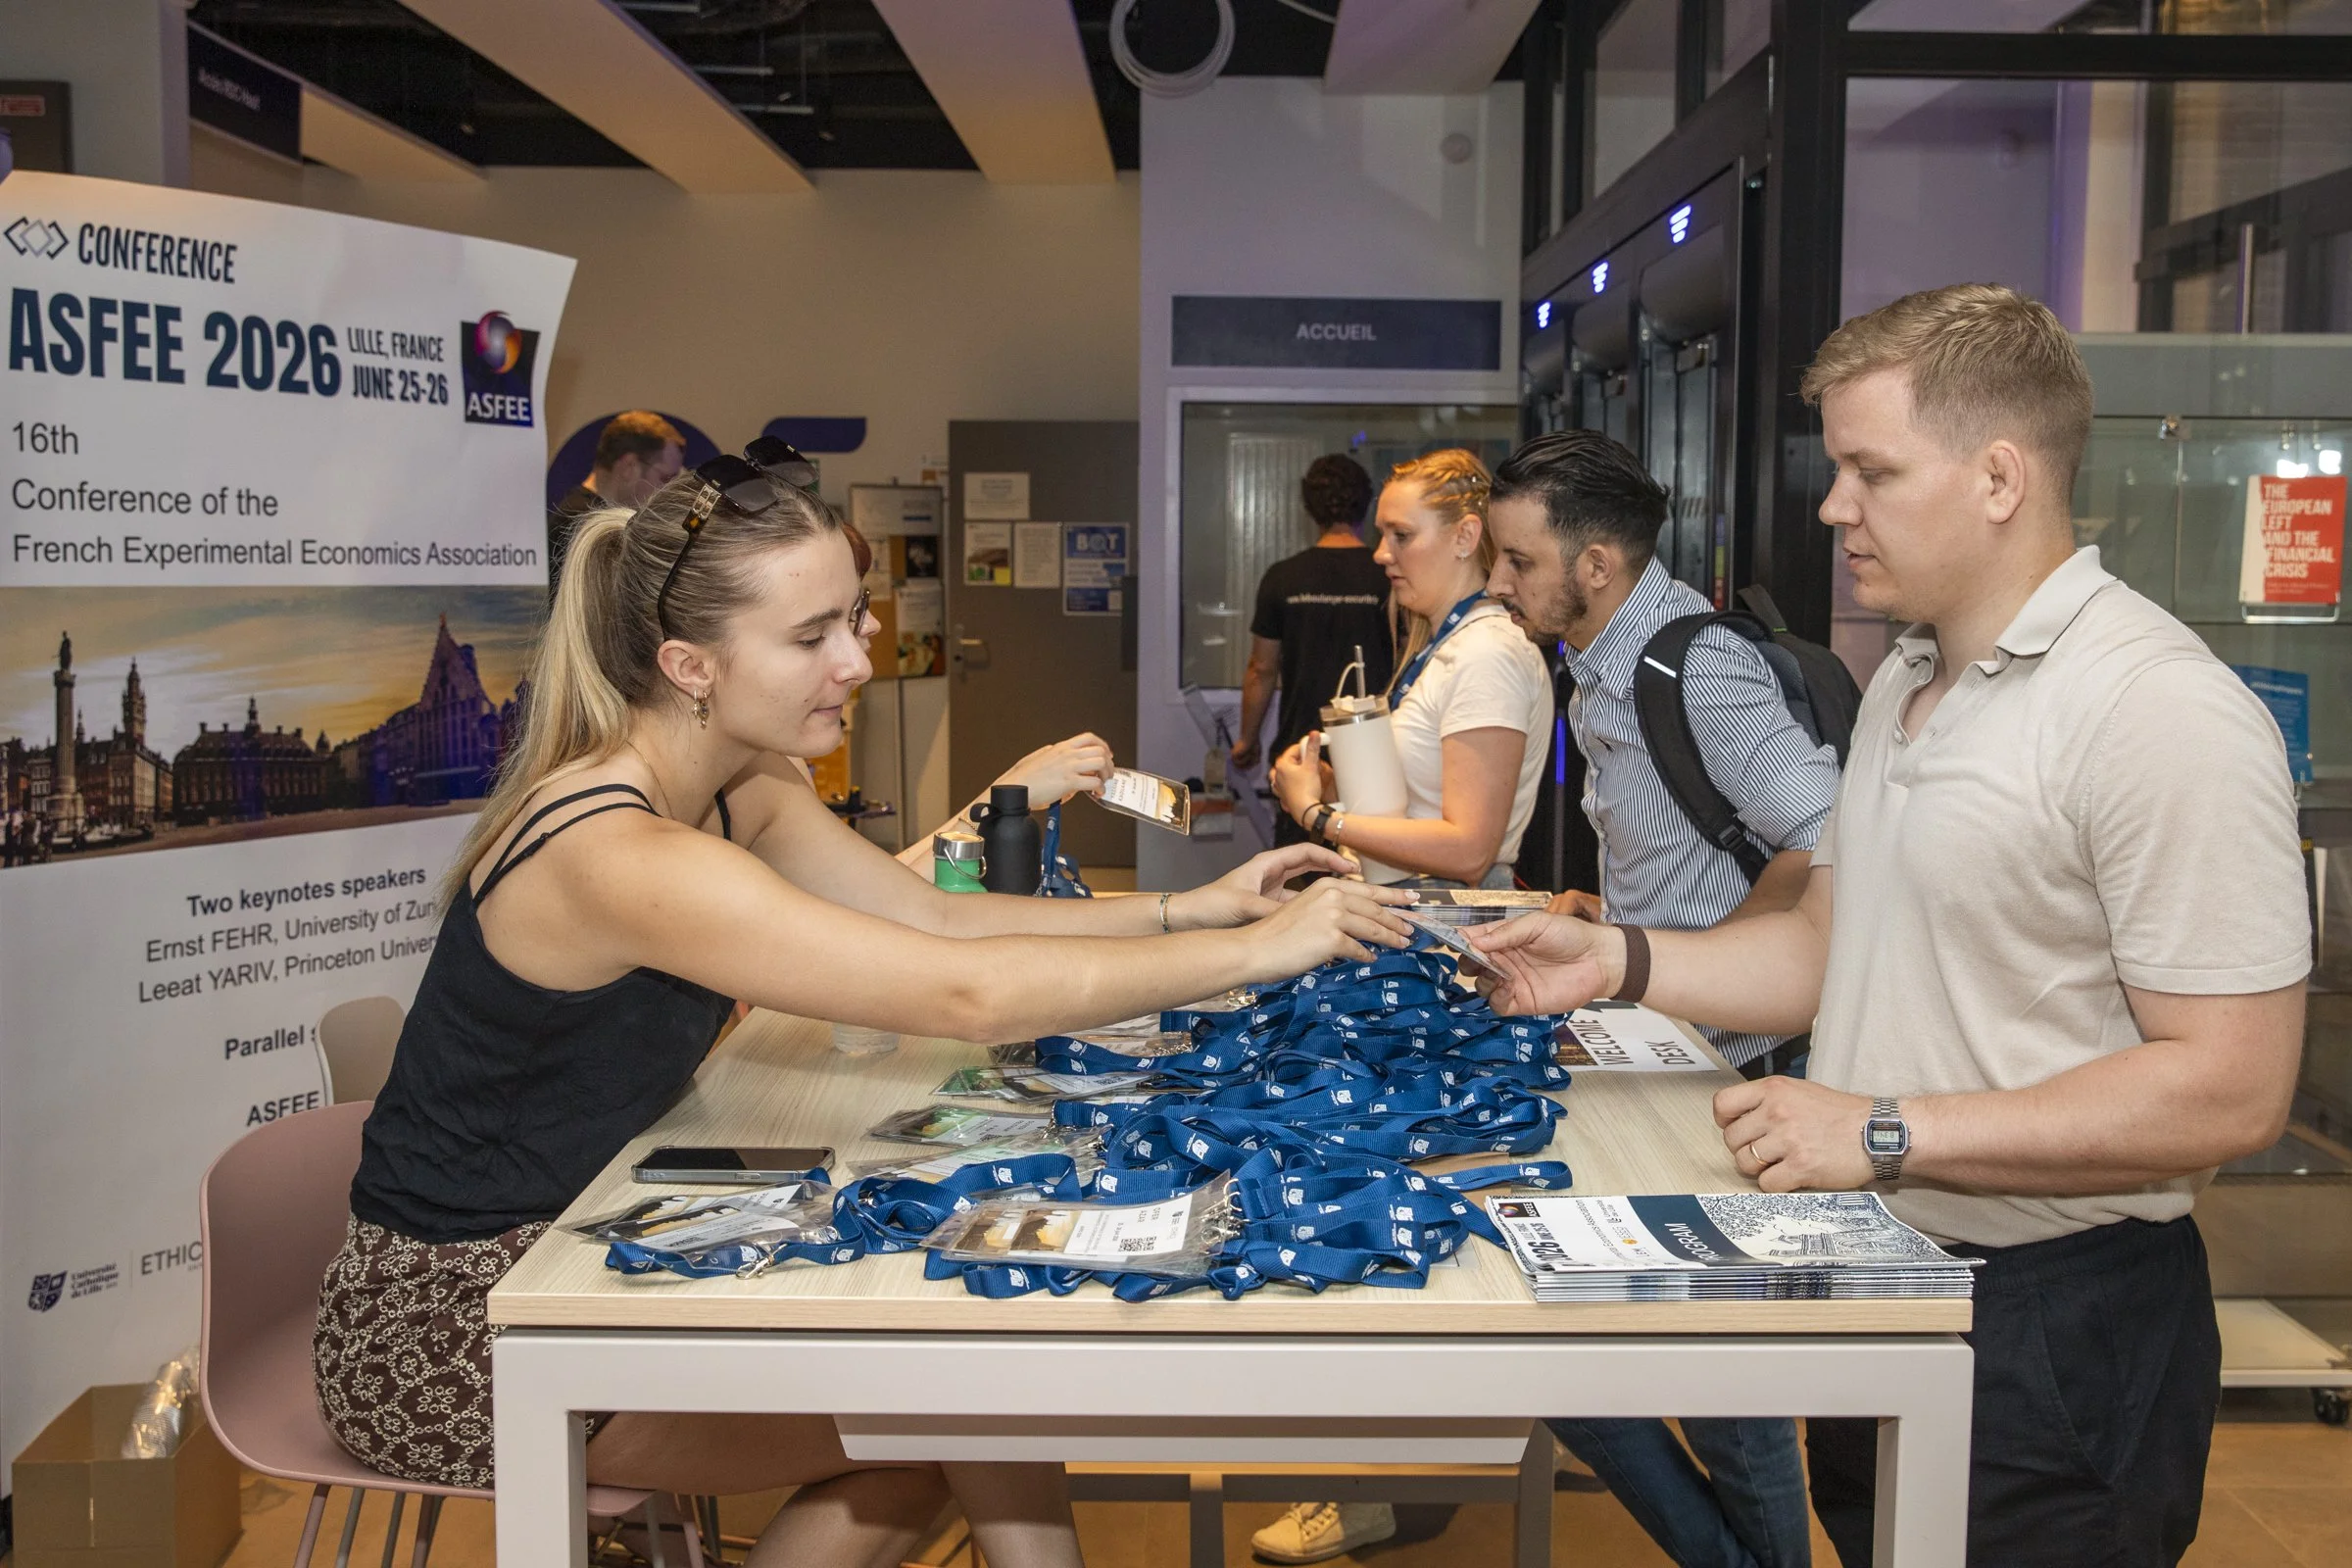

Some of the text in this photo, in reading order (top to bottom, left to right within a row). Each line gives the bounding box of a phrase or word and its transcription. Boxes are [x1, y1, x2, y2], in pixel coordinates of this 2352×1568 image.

[78, 222, 237, 283] CONFERENCE
[9, 287, 341, 396] ASFEE 2026
[347, 327, 444, 363] LILLE, FRANCE
[1297, 322, 1377, 341] ACCUEIL
[352, 365, 449, 406] JUNE 25-26
[466, 394, 530, 421] ASFEE
[13, 421, 79, 455] 16th
[12, 478, 278, 516] Conference of the
[2263, 499, 2332, 515] EUROPEAN
[2264, 483, 2288, 499] THE
[2262, 514, 2291, 530] LEFT
[2263, 530, 2320, 546] AND THE
[14, 534, 537, 570] French Experimental Economics Association
[2266, 547, 2336, 564] FINANCIAL
[2264, 563, 2309, 578] CRISIS
[187, 867, 426, 917] Two keynotes speakers
[146, 900, 437, 963] Ernst FEHR, University of Zur
[138, 974, 202, 1004] Leeat
[208, 960, 278, 992] YARIV,
[284, 946, 374, 979] Princeton
[225, 1024, 304, 1060] Parallel
[1569, 1019, 1634, 1065] WELCOME
[1644, 1041, 1696, 1065] DESK
[246, 1091, 319, 1127] ASFEE
[1523, 1201, 1539, 1217] ASFEE
[141, 1241, 202, 1275] ETHIC
[1664, 1223, 1729, 1261] PROGRAM
